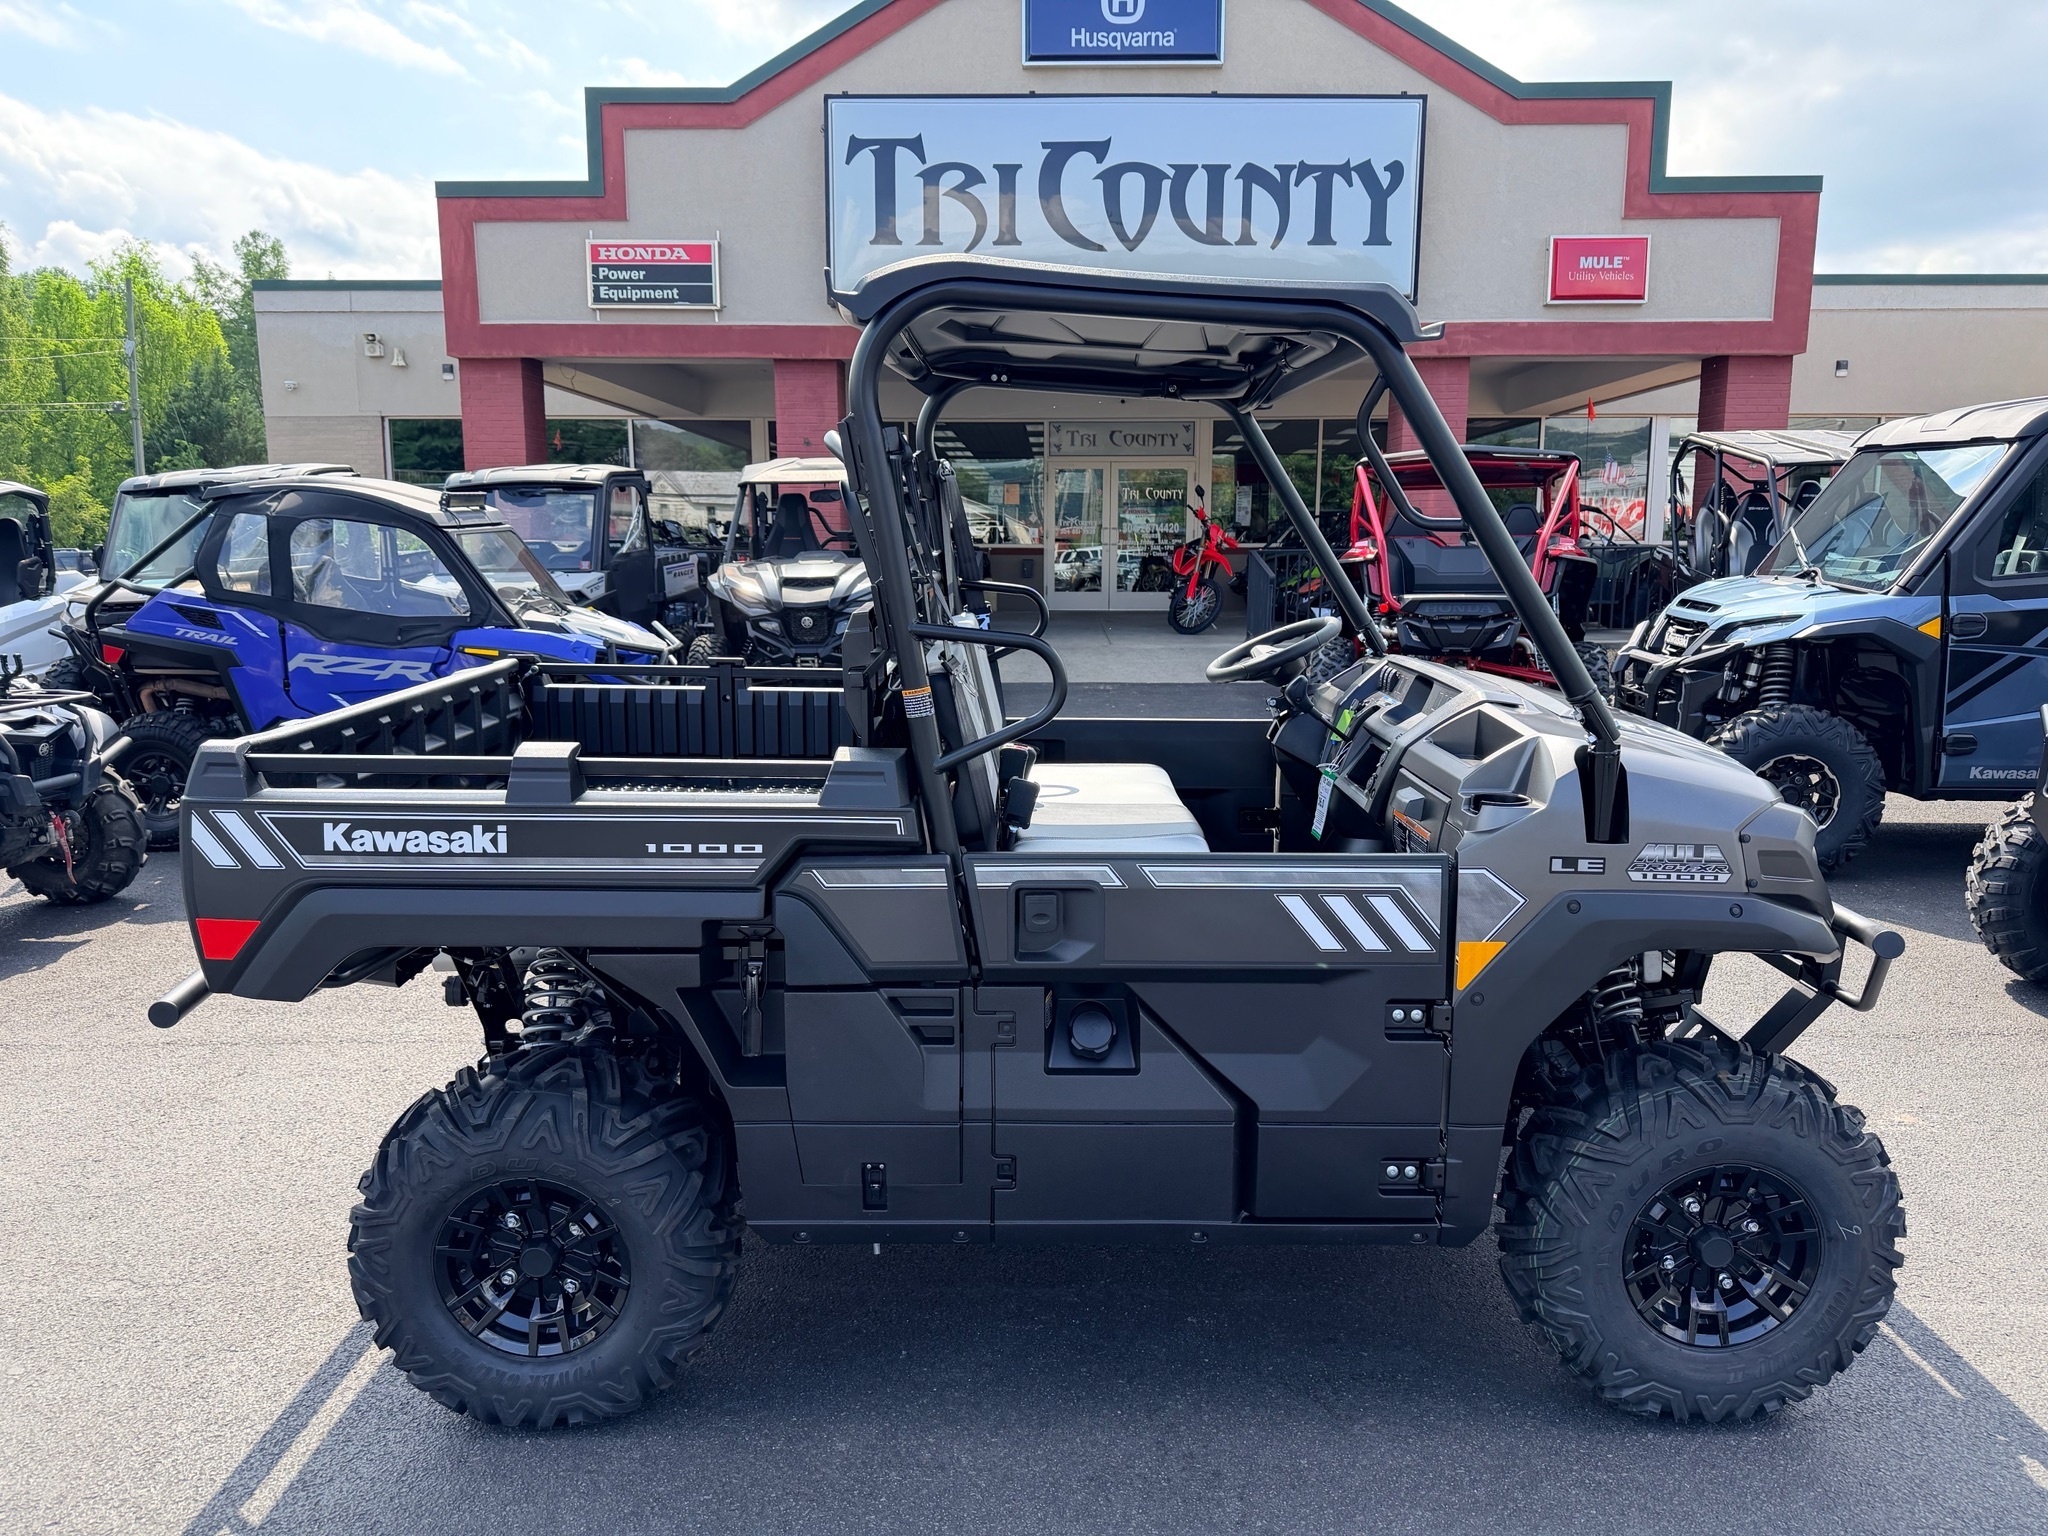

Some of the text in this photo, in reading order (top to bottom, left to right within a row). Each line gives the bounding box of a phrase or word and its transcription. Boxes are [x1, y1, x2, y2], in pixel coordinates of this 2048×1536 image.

[1071, 27, 1175, 50] Husqvarna
[1038, 136, 1404, 252] COUNTY
[598, 247, 690, 260] HONDA
[599, 267, 646, 279] Power
[1568, 271, 1634, 283] Utility Vehicles
[600, 286, 679, 301] Equipment
[1109, 430, 1179, 447] COUNTY
[1424, 604, 1495, 614] HONDA
[174, 627, 239, 646] TRAIL
[288, 652, 432, 683] RZR
[1969, 766, 2041, 780] Kawasa
[323, 822, 508, 854] Kawasaki
[645, 843, 763, 854] 1000
[1634, 844, 1728, 863] MULE
[1551, 858, 1605, 873] LE
[1641, 873, 1719, 881] 1000
